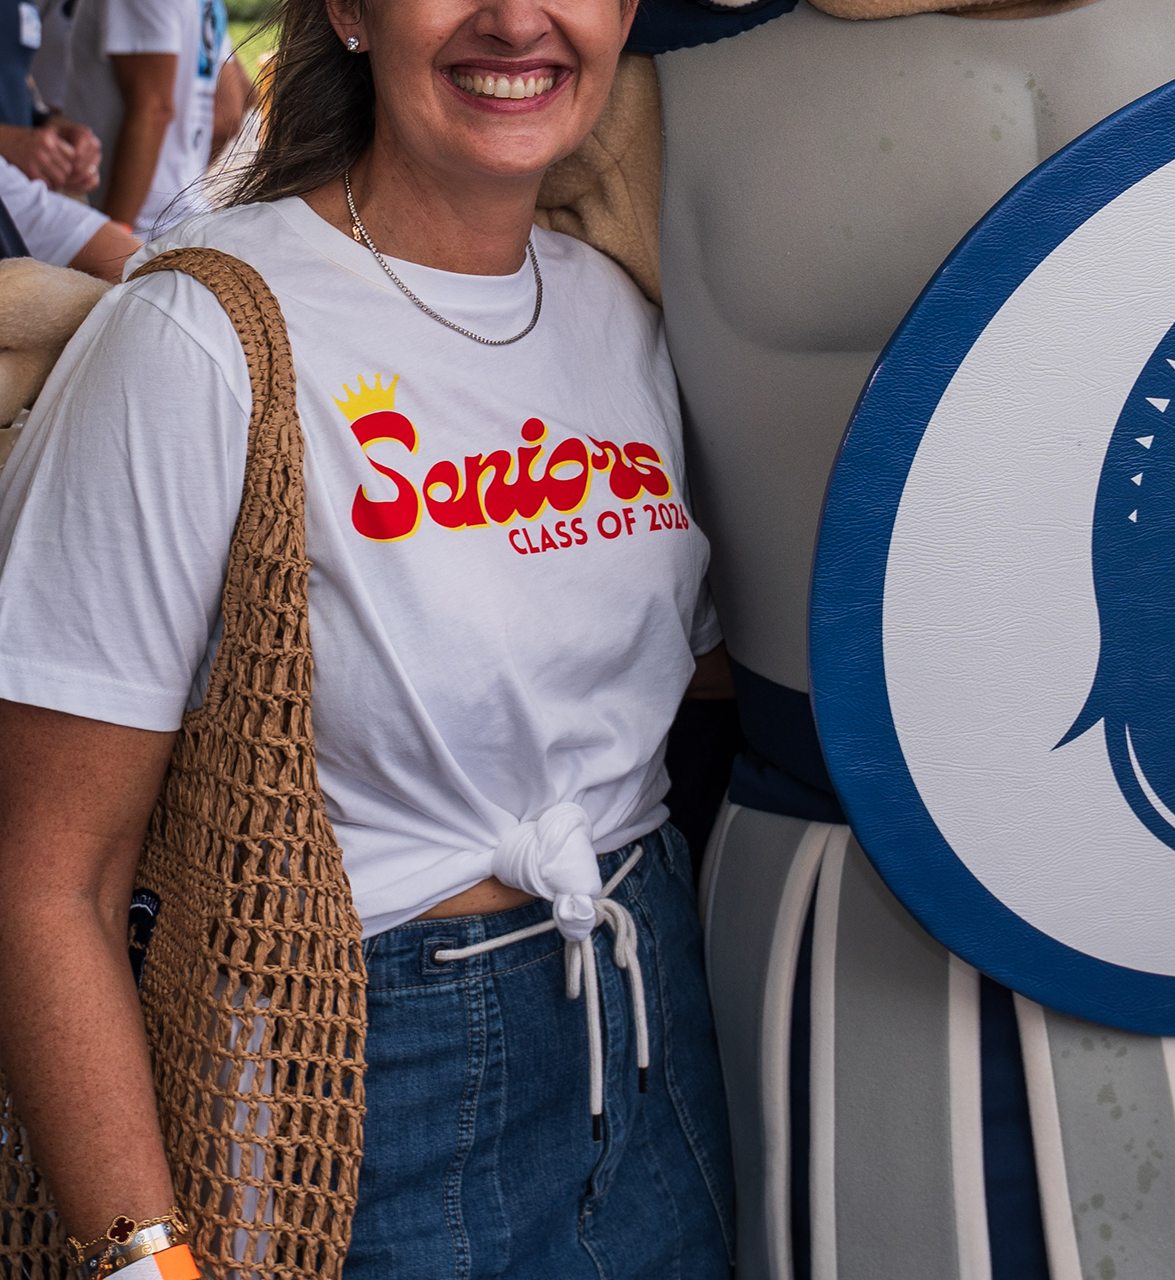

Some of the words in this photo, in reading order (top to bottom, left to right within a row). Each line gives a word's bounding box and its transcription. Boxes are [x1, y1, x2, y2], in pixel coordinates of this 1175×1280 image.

[351, 410, 673, 543] Seniors
[508, 518, 588, 555] CLASS
[597, 507, 636, 540] OF
[643, 502, 690, 533] 2026
